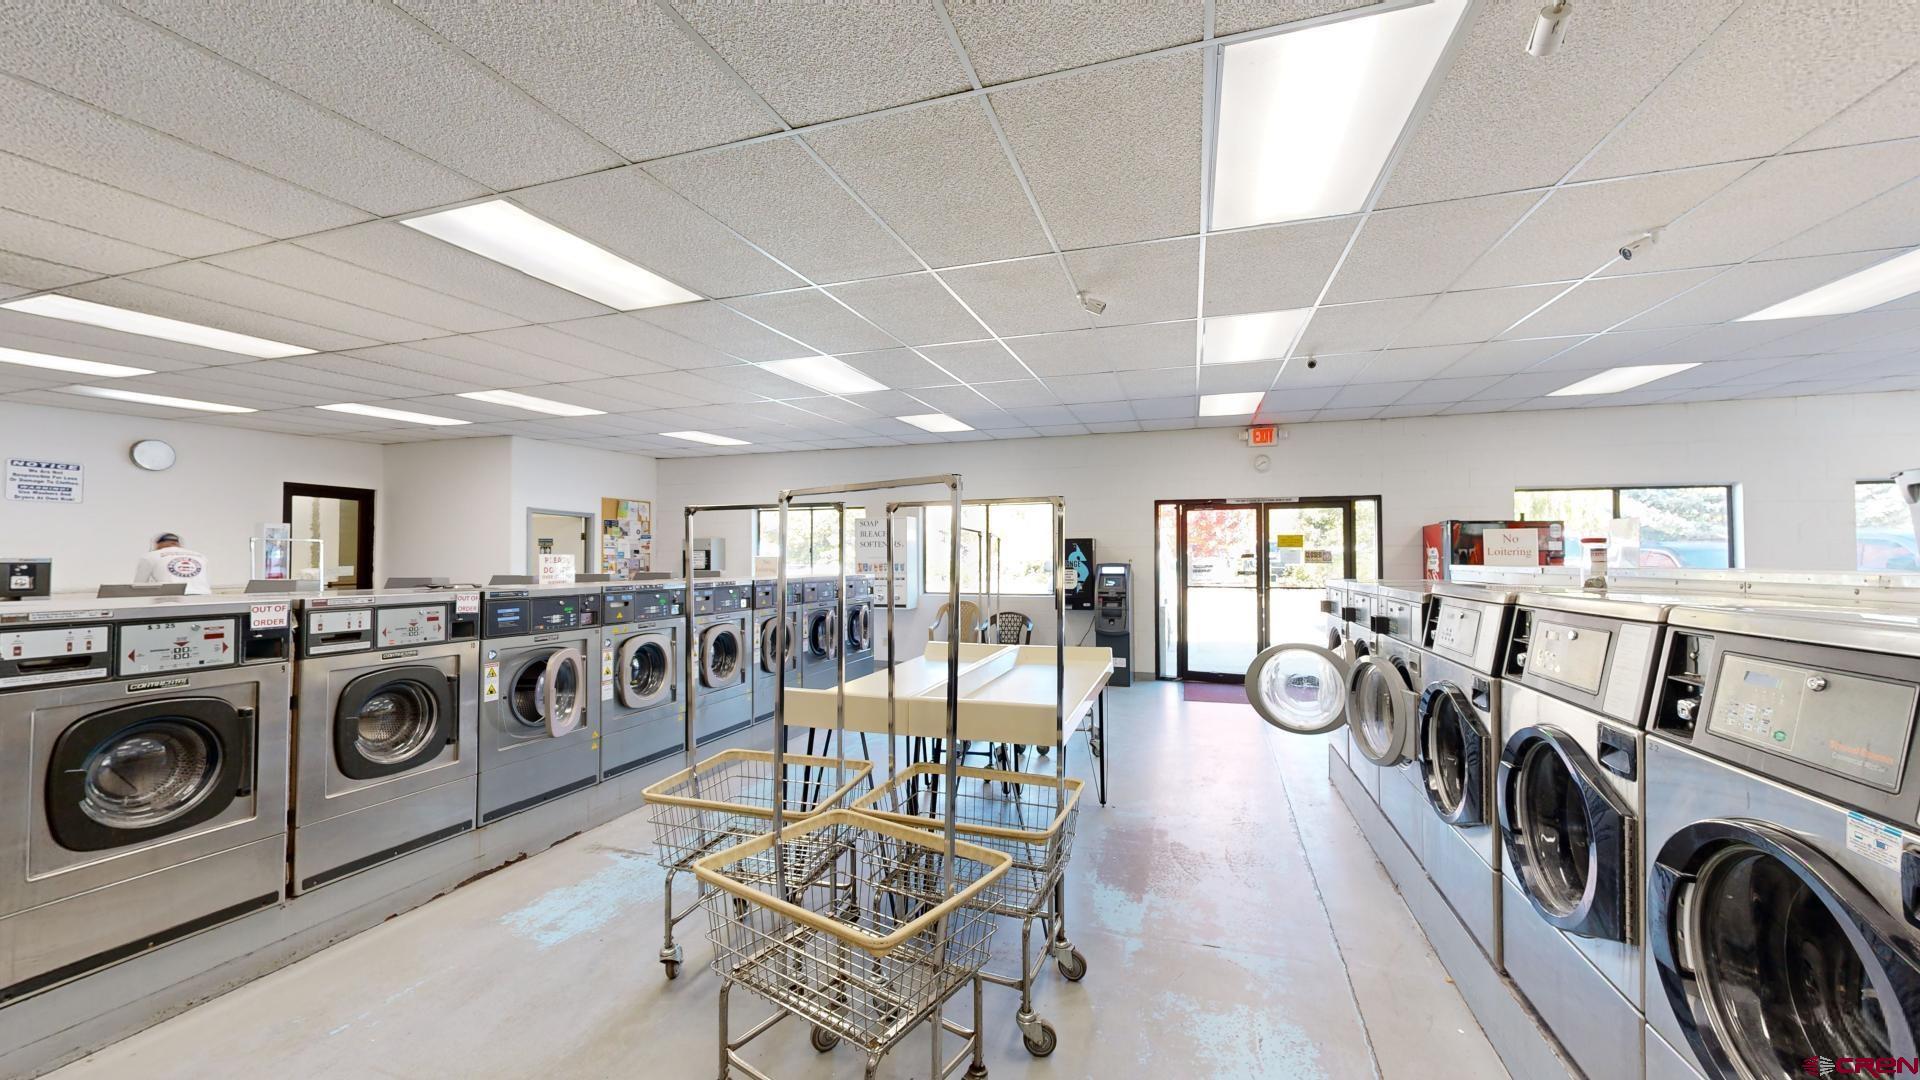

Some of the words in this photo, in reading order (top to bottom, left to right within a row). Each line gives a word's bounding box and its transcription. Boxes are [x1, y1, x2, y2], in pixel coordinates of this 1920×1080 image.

[1252, 428, 1273, 443] EXIT
[12, 460, 80, 470] NOTICE
[1502, 534, 1519, 544] No
[1487, 547, 1532, 558] Loitering
[252, 605, 272, 613] OUT
[253, 618, 284, 626] ORDER
[1649, 742, 1659, 752] 22
